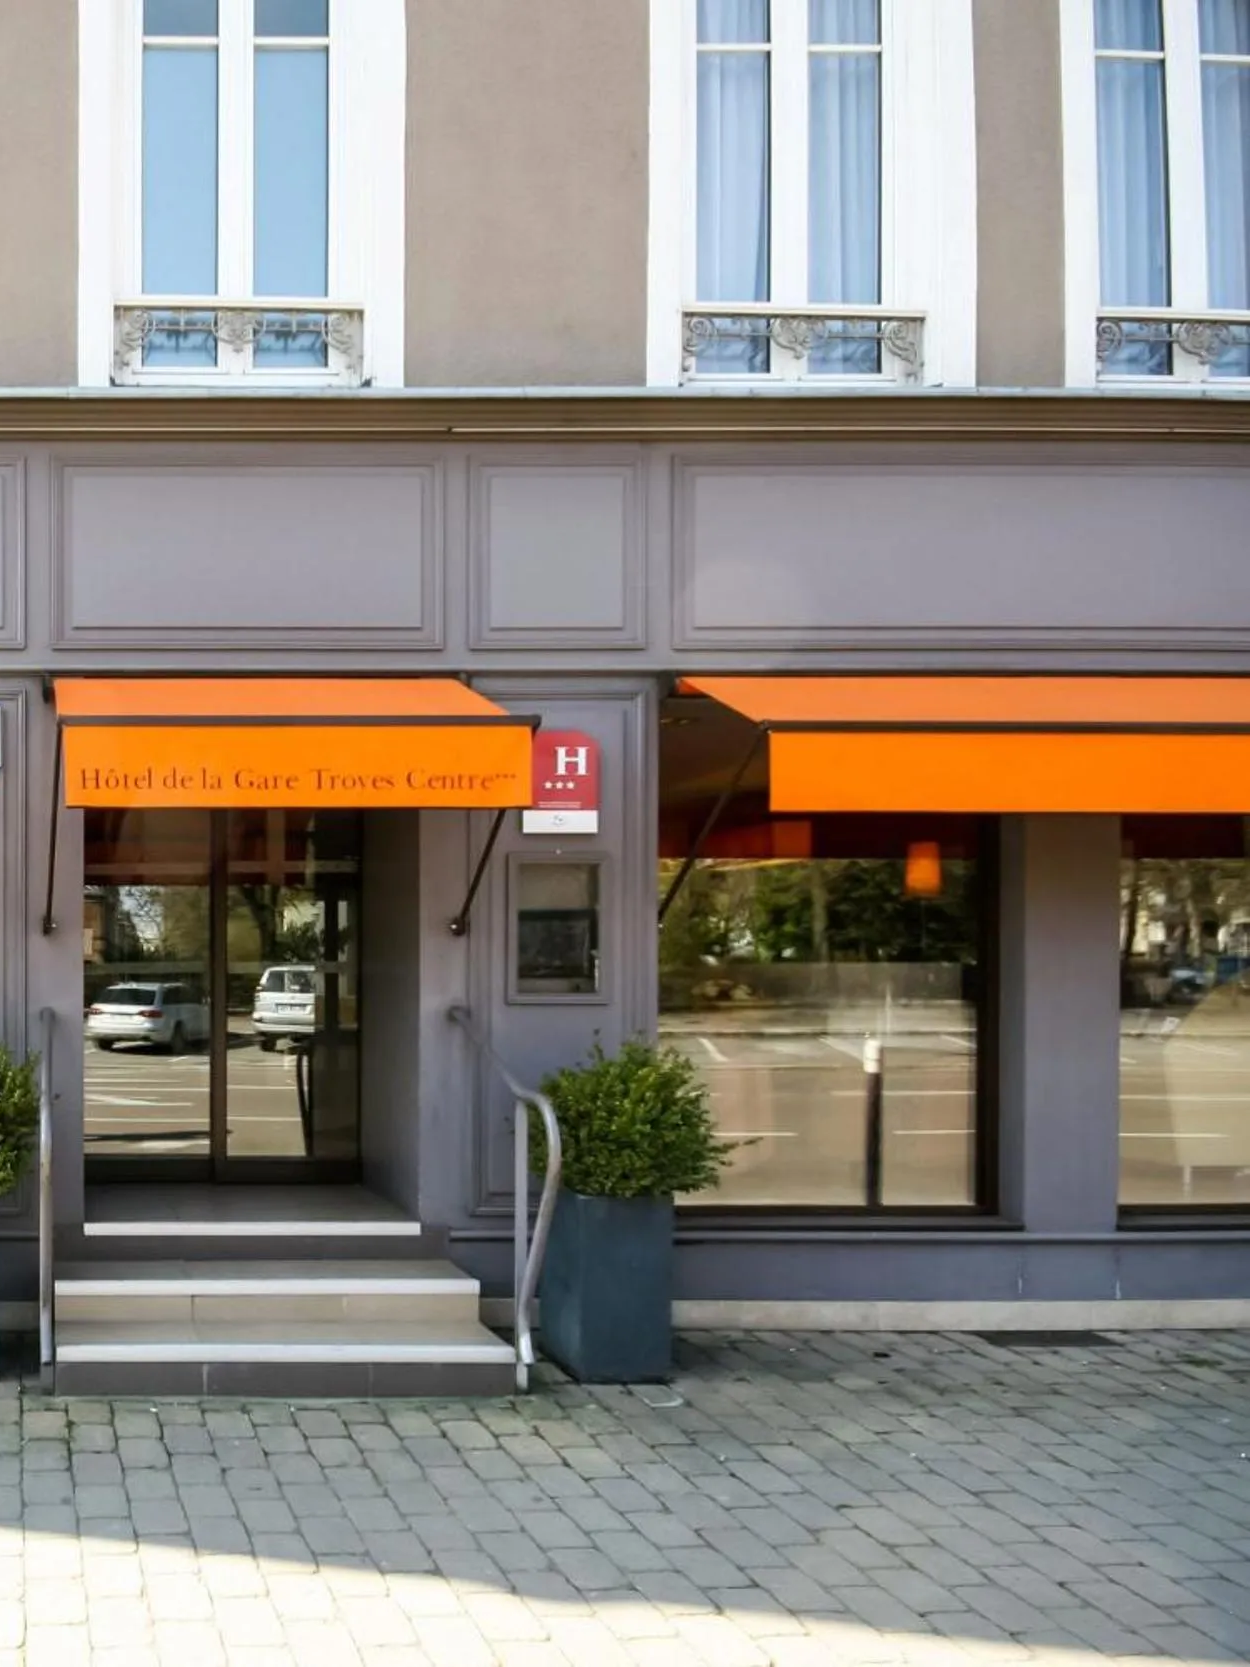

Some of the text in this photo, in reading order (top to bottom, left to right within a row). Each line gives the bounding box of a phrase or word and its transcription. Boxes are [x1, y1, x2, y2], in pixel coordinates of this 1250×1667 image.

[554, 746, 590, 776] H
[80, 767, 153, 790] Hôtel
[162, 767, 194, 790] de
[202, 767, 222, 790] la
[234, 768, 299, 791] Gare
